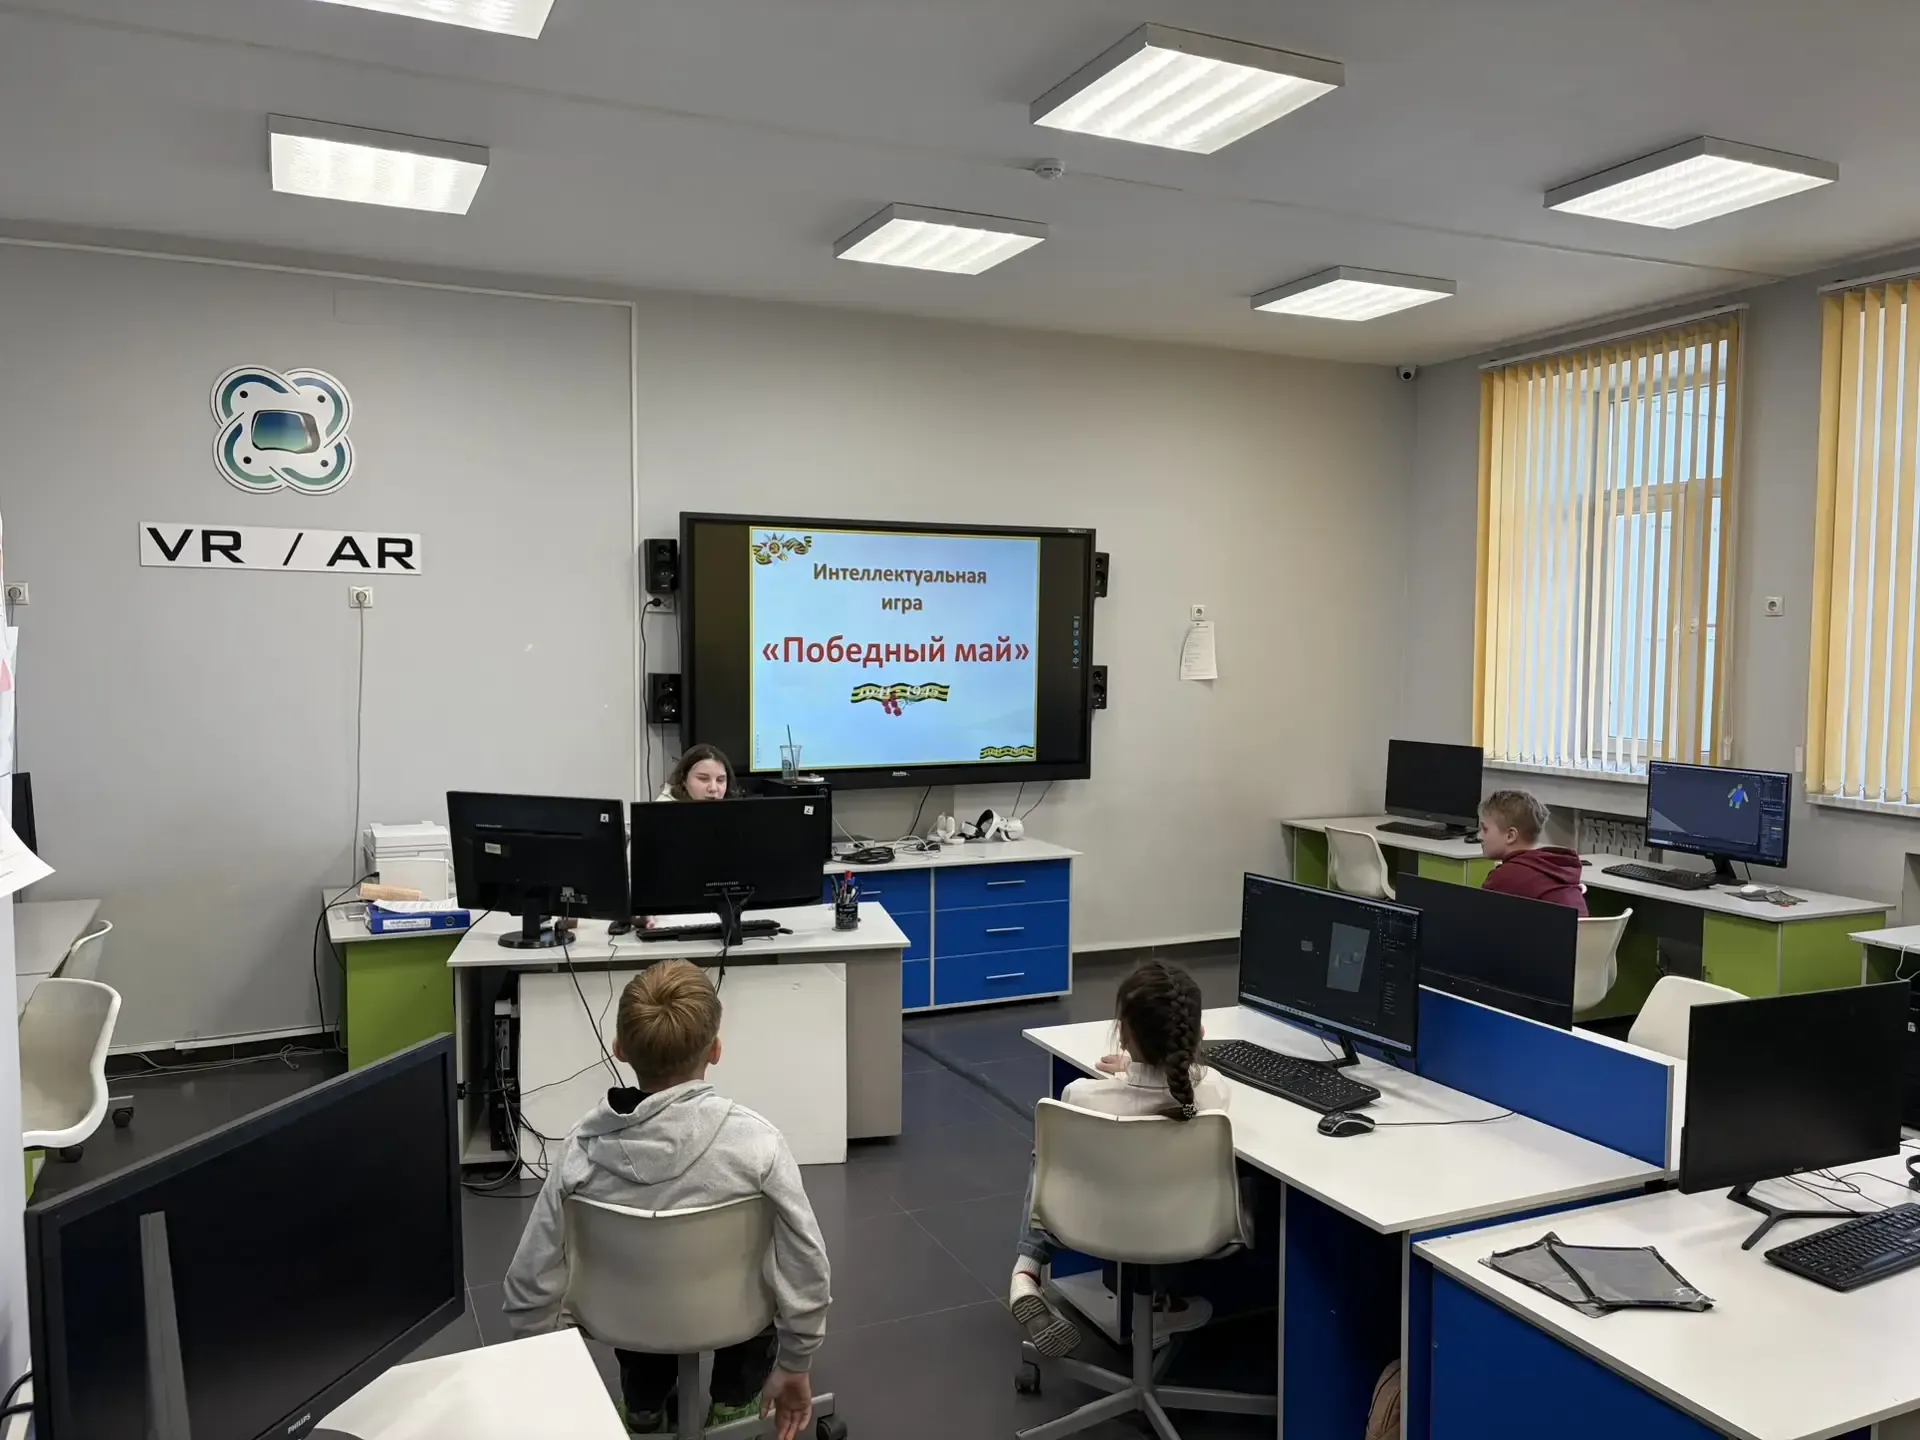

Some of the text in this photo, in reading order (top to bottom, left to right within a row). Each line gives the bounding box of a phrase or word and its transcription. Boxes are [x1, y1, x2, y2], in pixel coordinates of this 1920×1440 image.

[146, 527, 416, 570] VR / AR
[813, 562, 987, 586] Интеллектуальная
[881, 595, 923, 614] игра
[762, 634, 1030, 668] «Победный май»
